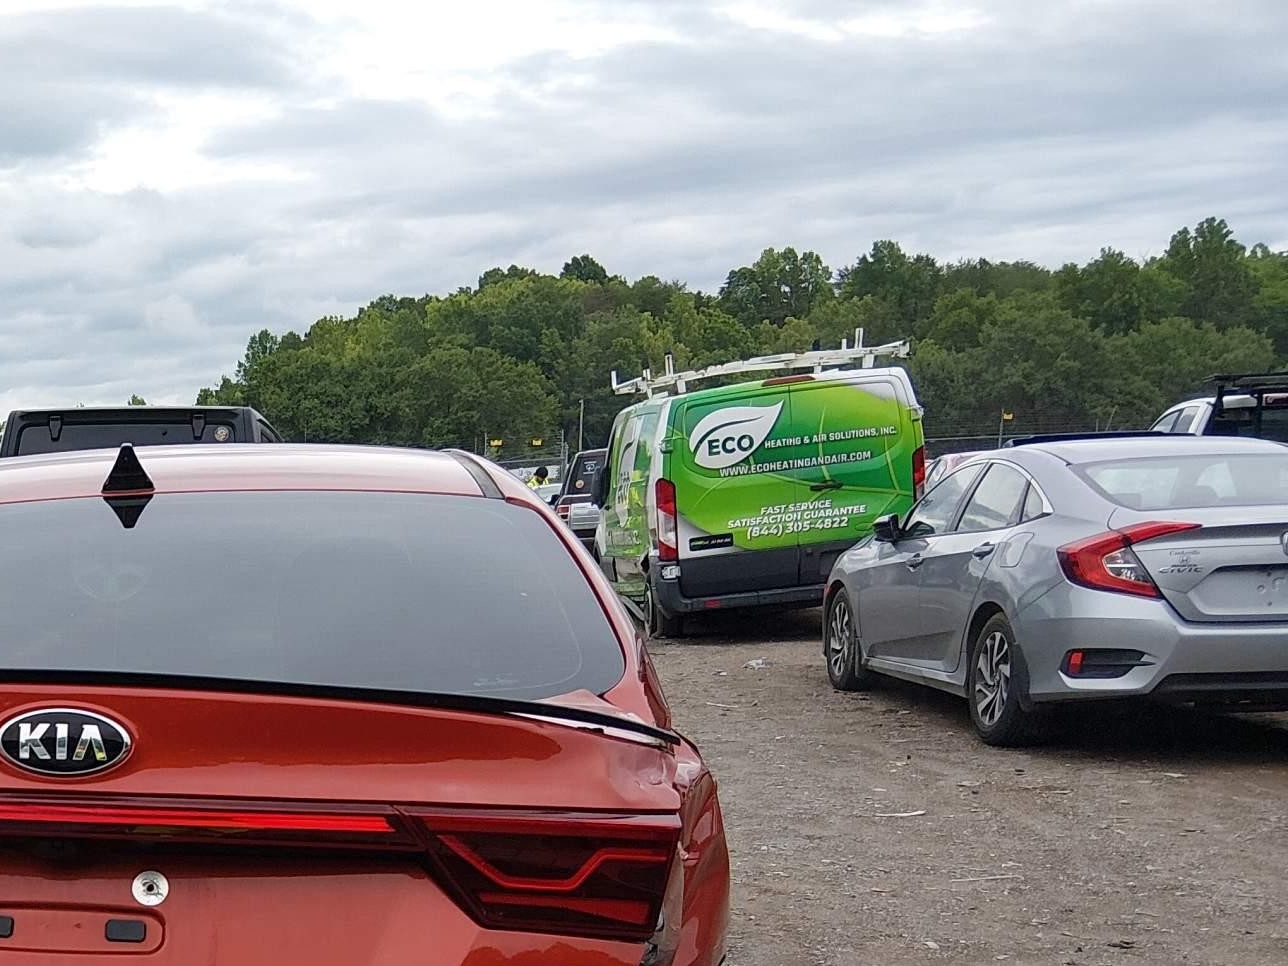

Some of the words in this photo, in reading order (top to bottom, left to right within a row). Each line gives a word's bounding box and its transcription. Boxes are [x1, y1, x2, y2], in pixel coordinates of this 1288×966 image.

[707, 434, 755, 457] ECO
[764, 436, 802, 449] HEATING
[803, 436, 810, 444] &
[812, 433, 827, 443] AIR
[828, 427, 879, 441] SOLUTIONS,
[880, 426, 897, 435] INC.
[719, 451, 872, 478] WWW.ECOHEATINGANDAIR.COM
[727, 511, 801, 529] SATISFACTION
[803, 504, 867, 520] GUARANTEE
[760, 504, 787, 515] FAST
[788, 499, 832, 512] SERVICE
[747, 523, 783, 540] (844)
[784, 516, 849, 534] 305-4822
[1158, 566, 1204, 575] CIVIC
[18, 722, 108, 761] KIA
